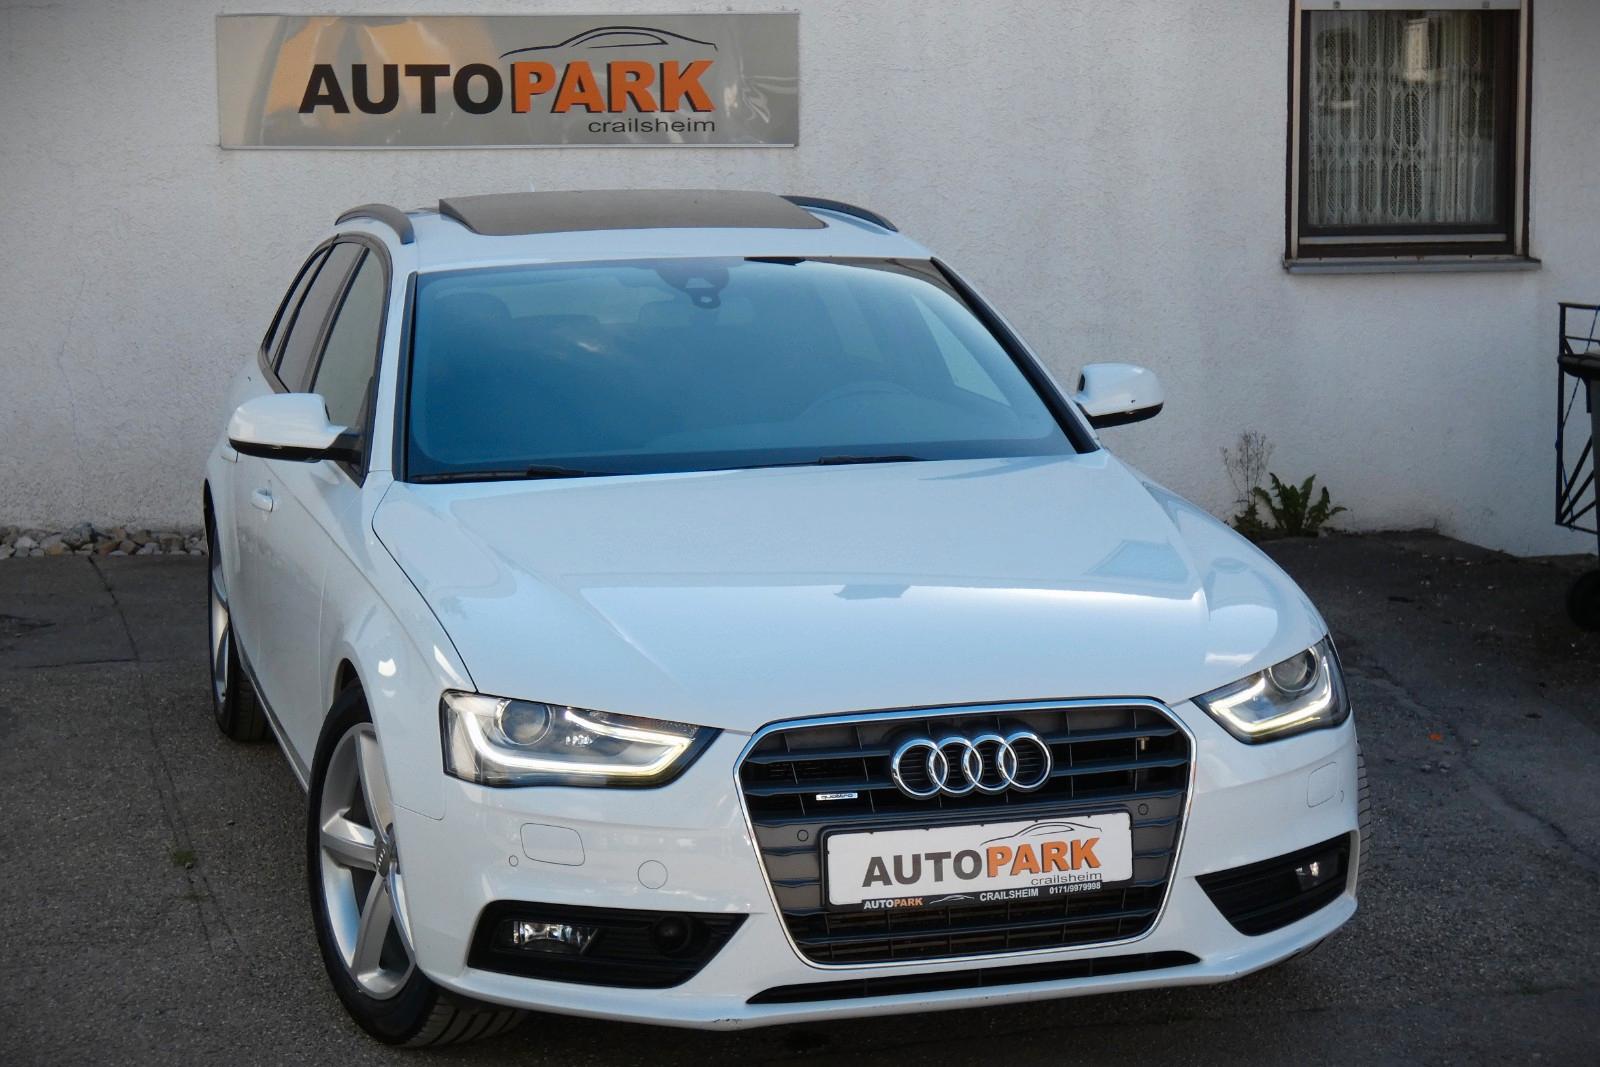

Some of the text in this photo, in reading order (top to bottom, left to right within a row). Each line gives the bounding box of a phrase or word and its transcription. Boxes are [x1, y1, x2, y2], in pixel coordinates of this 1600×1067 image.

[298, 59, 715, 115] AUTOPARK
[588, 118, 715, 133] crailsheim
[861, 837, 1102, 888] AUTOPARK
[1030, 872, 1102, 886] crailsheim
[863, 897, 923, 910] AUTOPARK
[979, 888, 1039, 902] CRAILSHEIM
